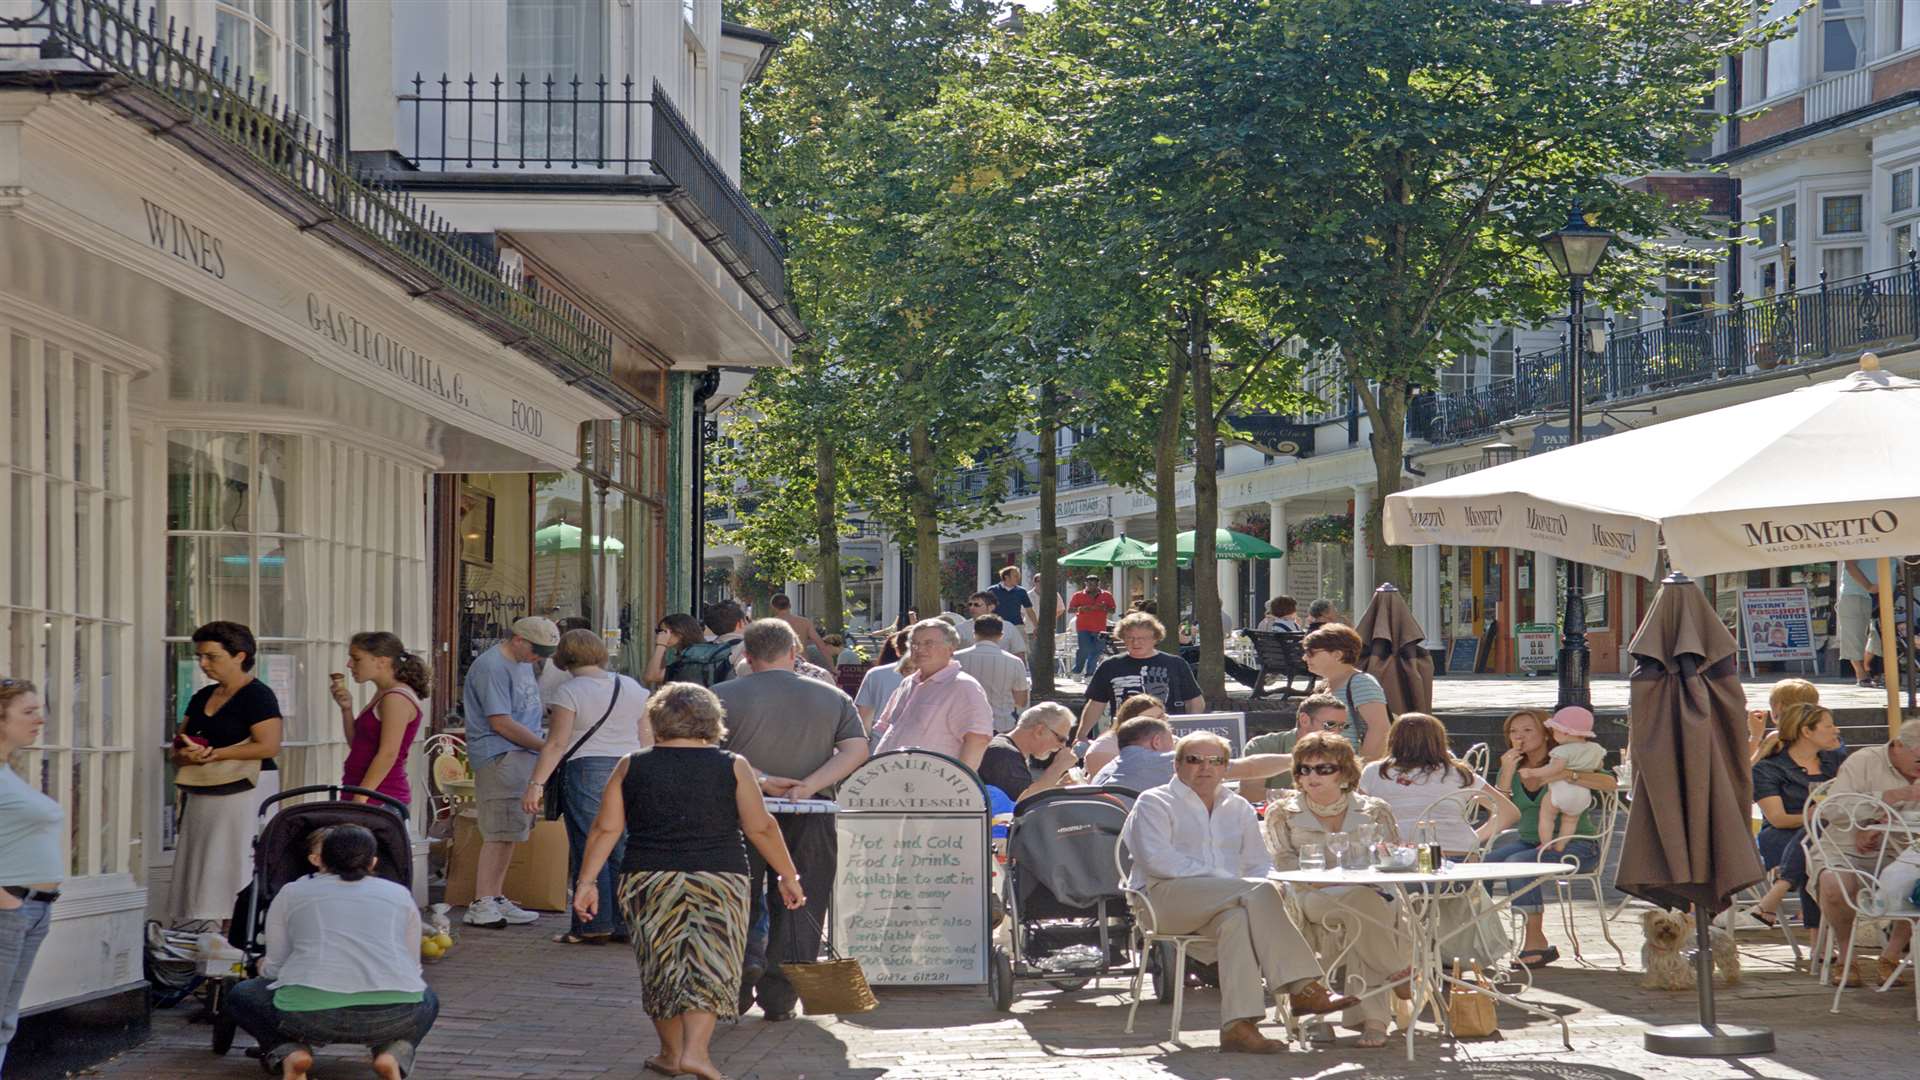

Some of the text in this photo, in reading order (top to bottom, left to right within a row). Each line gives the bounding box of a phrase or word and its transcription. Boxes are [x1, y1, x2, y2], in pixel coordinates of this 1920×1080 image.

[141, 198, 224, 279] WINES
[511, 399, 543, 438] FOOD
[1742, 509, 1898, 548] MIONETTO
[847, 759, 972, 796] RESTAURANT
[847, 797, 970, 808] DELICATESSEN
[849, 833, 963, 850] Hot and Cold
[846, 853, 887, 868] Food
[843, 871, 976, 887] Available to eat in
[855, 889, 873, 898] or
[880, 889, 913, 900] take
[848, 914, 973, 930] Restaurant also
[954, 942, 977, 954] and
